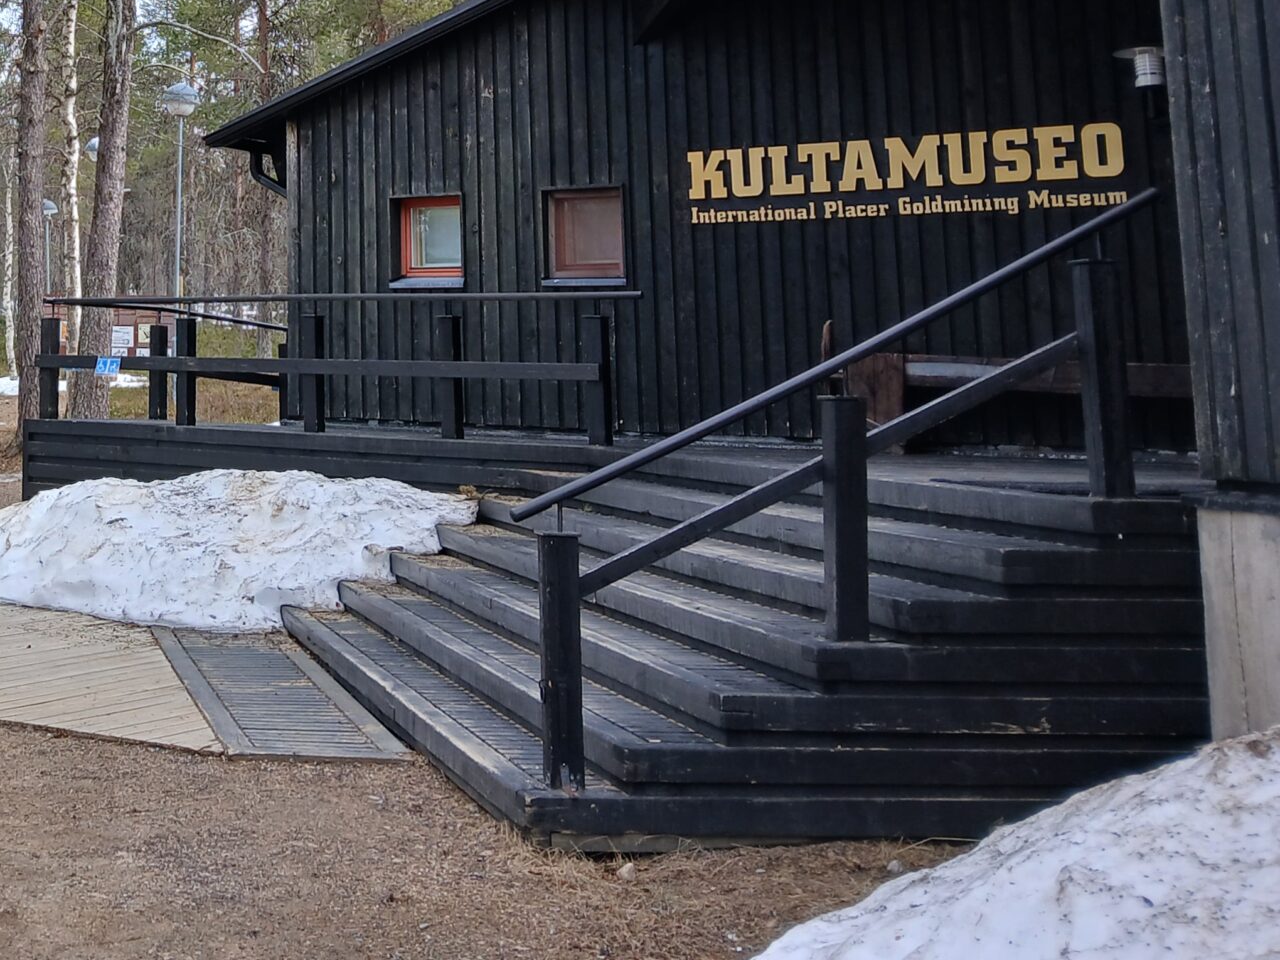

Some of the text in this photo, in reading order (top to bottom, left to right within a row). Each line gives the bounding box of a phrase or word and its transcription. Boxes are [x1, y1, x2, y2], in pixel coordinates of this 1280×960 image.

[687, 121, 1125, 200] KULTAMUSEO
[691, 189, 1128, 224] International Placer Goldmining Museum
